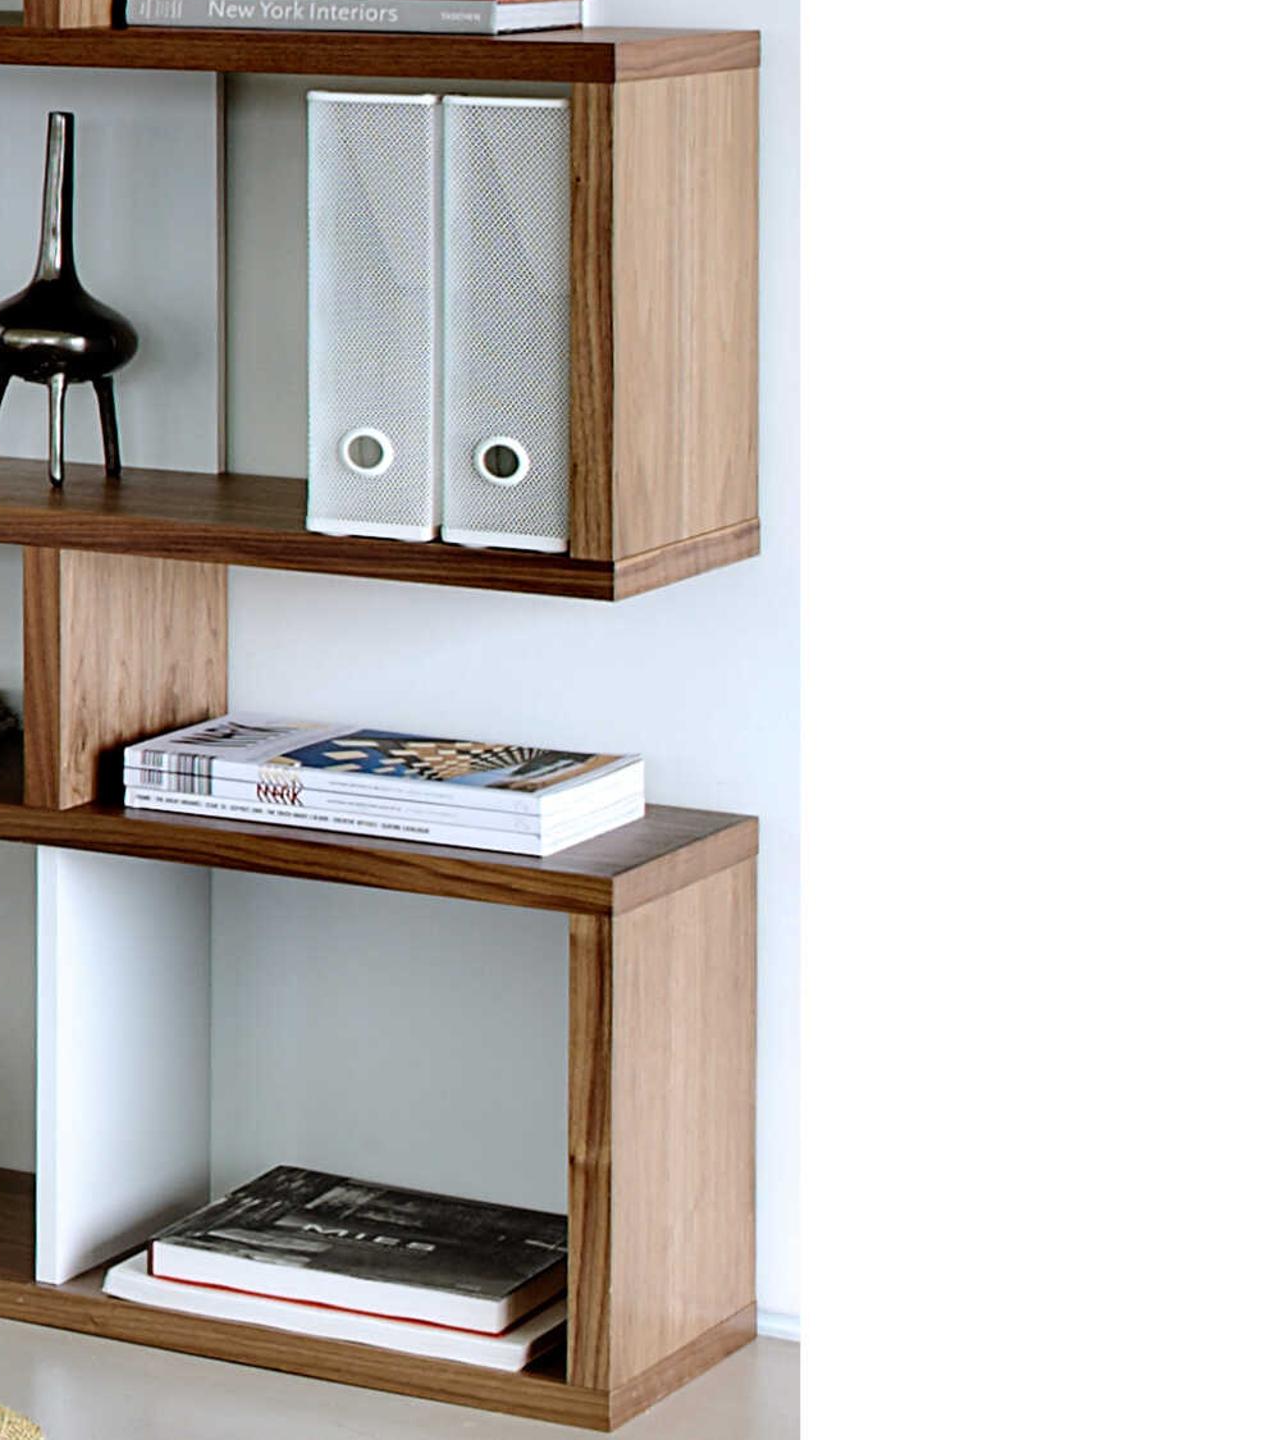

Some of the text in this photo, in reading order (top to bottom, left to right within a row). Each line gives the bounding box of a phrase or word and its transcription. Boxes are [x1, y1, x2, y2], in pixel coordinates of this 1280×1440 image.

[208, 0, 399, 23] New York Interiors
